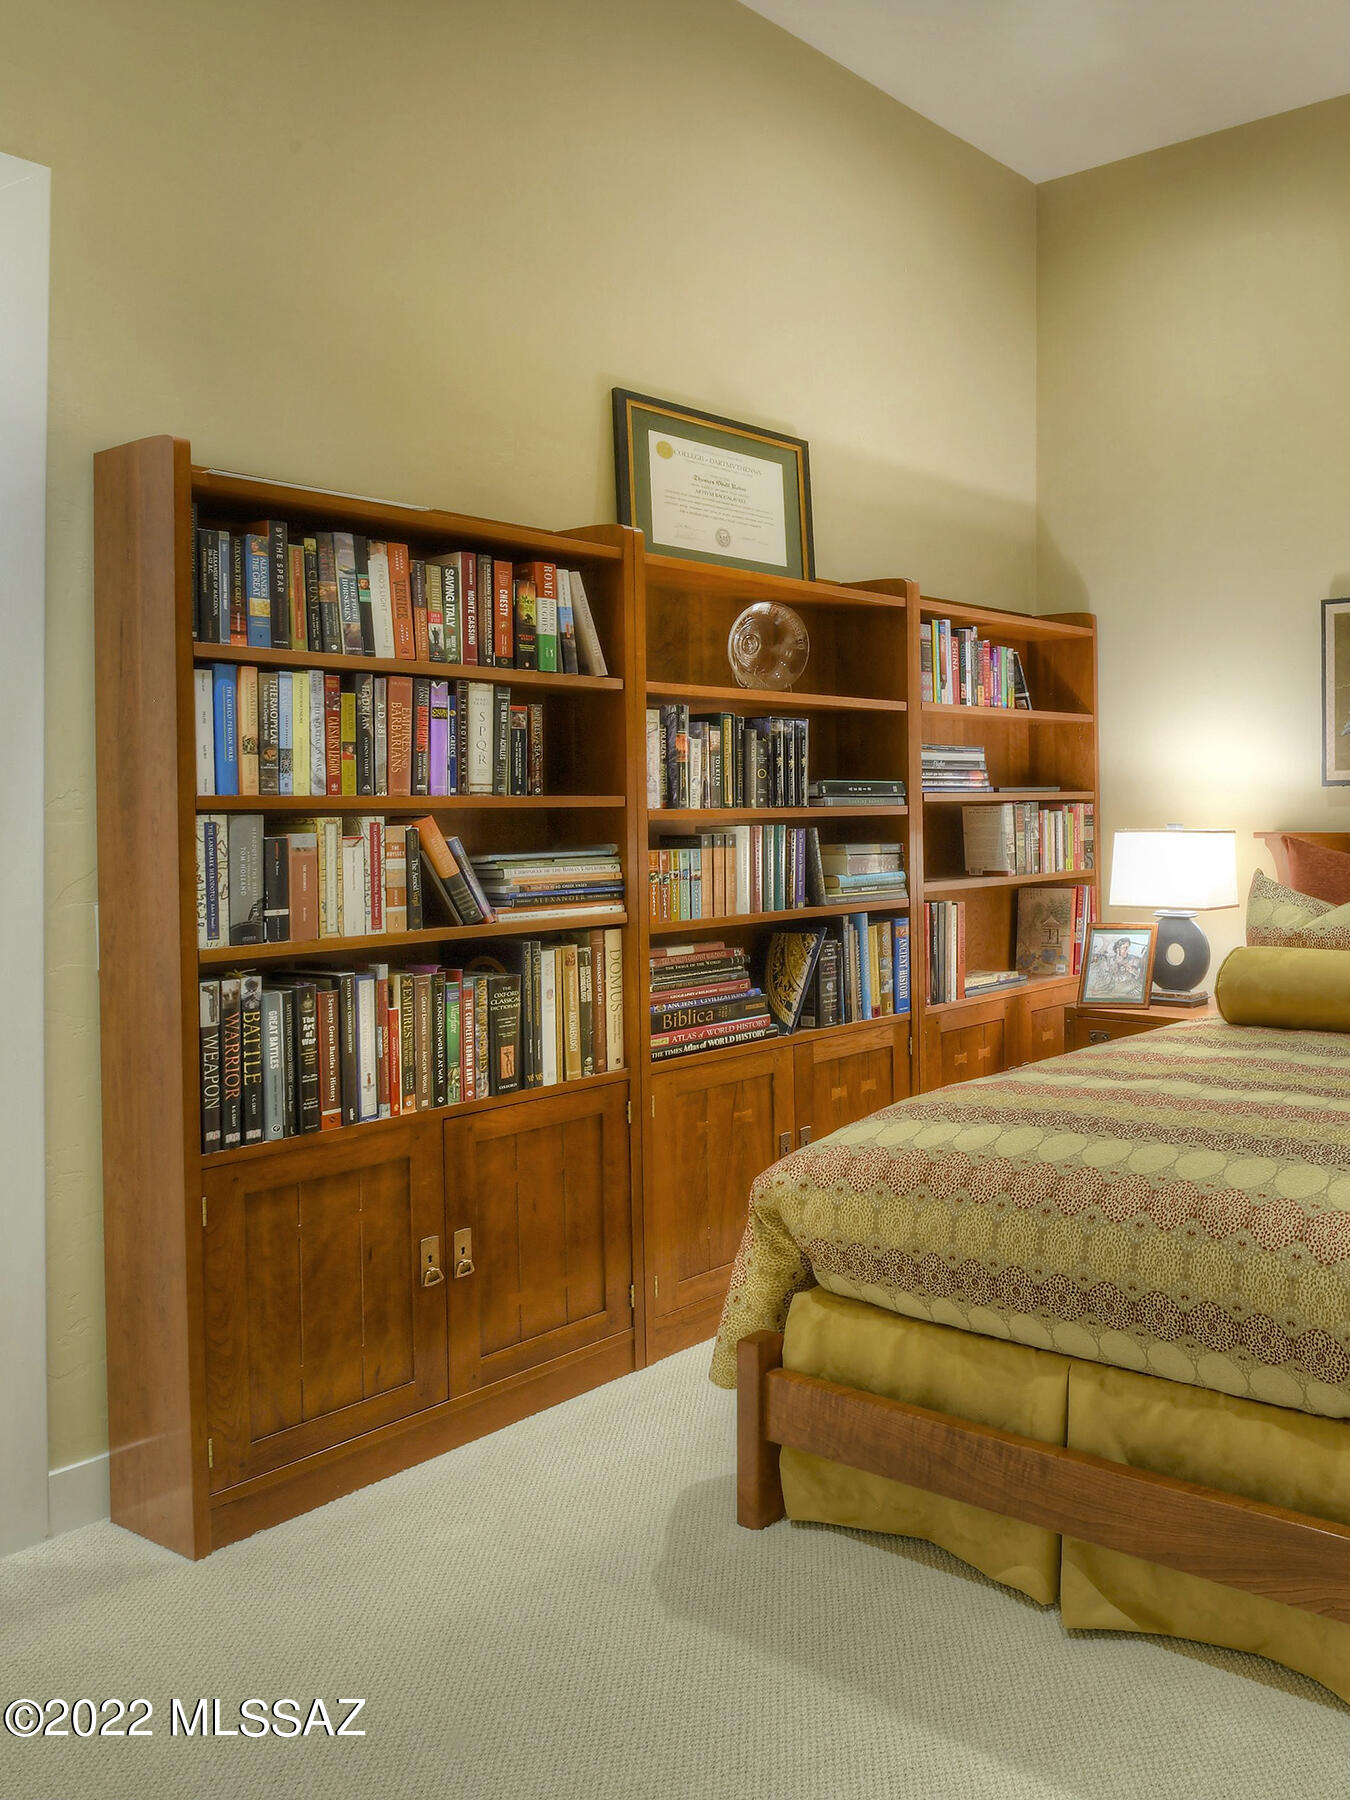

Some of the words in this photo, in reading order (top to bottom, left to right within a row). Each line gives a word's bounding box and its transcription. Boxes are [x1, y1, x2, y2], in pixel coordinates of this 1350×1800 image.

[275, 527, 283, 539] BY
[252, 557, 261, 570] THE
[276, 541, 284, 560] THE
[252, 571, 260, 597] GREAT
[260, 556, 269, 598] ALEXANDER
[276, 562, 284, 593] SPEAR
[309, 570, 319, 611] CLUNY
[445, 567, 455, 602] SAVING
[543, 565, 553, 597] ROME
[393, 579, 409, 620] VENICE
[467, 590, 476, 614] MONTE
[499, 589, 509, 617] CHESTY
[446, 602, 456, 628] ITALY
[467, 615, 477, 646] CASSINO
[951, 640, 959, 671] CHINA
[249, 681, 258, 727] MARATHON
[269, 679, 279, 745] THERMOPYLAE
[361, 685, 371, 729] HADRIAN
[377, 703, 386, 721] A.D.
[377, 723, 386, 738] 381
[391, 702, 403, 774] BARBARIANS
[401, 707, 412, 753] EMPIRES
[460, 720, 468, 753] TROJAN
[328, 750, 341, 777] LEGION
[460, 756, 468, 777] WAR
[239, 847, 248, 859] TOM
[239, 863, 248, 897] HOLLAND
[533, 895, 585, 904] ALEXANDER
[898, 936, 908, 968] ANCIENT
[493, 990, 519, 999] OXFORD
[609, 949, 623, 1013] DOMUS
[899, 969, 908, 1000] HISTORY
[327, 998, 335, 1024] Seventy
[402, 988, 414, 1039] EMPIRES
[465, 999, 473, 1010] THE
[490, 997, 521, 1006] CLASSICAL
[490, 1003, 521, 1011] DICTIONARY
[667, 1000, 698, 1010] ANCIENT
[268, 1010, 279, 1035] GREAT
[302, 1016, 315, 1024] The
[448, 1004, 460, 1034] Warfare
[662, 1008, 714, 1029] Biblica
[672, 1032, 697, 1043] ATLAS
[706, 1025, 735, 1036] WORLD
[735, 1019, 768, 1030] HISTORY
[243, 1011, 262, 1086] BATTLE
[301, 1038, 317, 1046] War
[328, 1026, 336, 1044] Great
[664, 1048, 684, 1056] TIMES
[684, 1043, 700, 1052] Atlas
[700, 1040, 707, 1048] of
[707, 1035, 735, 1047] WORLD
[735, 1029, 766, 1041] HISTORY
[224, 1011, 241, 1101] WARRIOR
[269, 1036, 280, 1071] BATTLES
[203, 1033, 220, 1110] WEAPON
[330, 1077, 338, 1102] History
